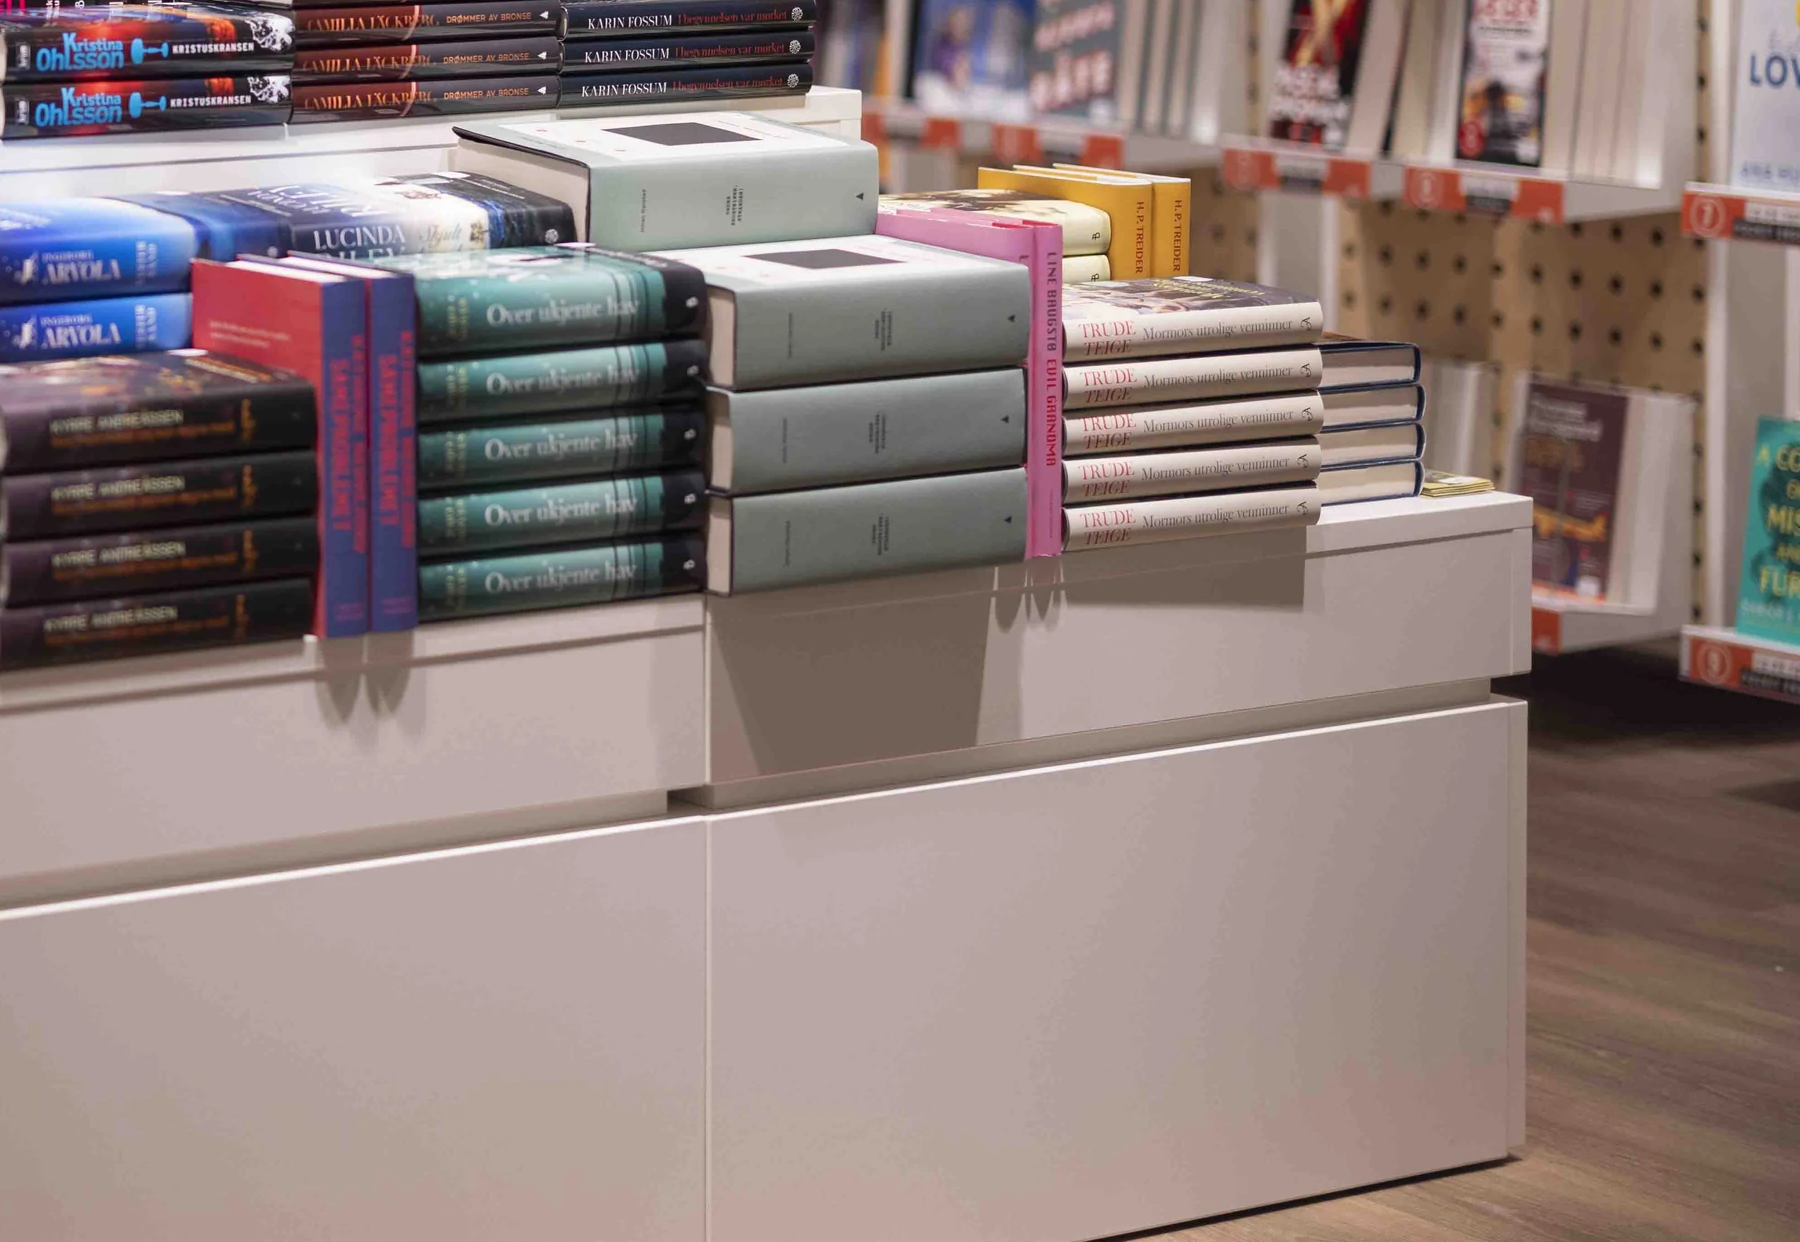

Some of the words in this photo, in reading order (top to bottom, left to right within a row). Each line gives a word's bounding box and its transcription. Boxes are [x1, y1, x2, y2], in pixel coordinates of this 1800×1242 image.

[588, 17, 625, 30] KARIN
[628, 14, 672, 28] FOSSUM
[683, 12, 738, 26] begynnelsen
[741, 13, 754, 22] var
[757, 10, 787, 21] mørket
[61, 32, 124, 51] Kristina
[173, 42, 254, 54] KRISTUSKRANSEN
[36, 45, 124, 71] Ohlsson
[585, 50, 621, 64] KARIN
[625, 48, 669, 61] FOSSUM
[1749, 51, 1800, 89] LOV
[61, 87, 121, 106] Kristina
[170, 95, 251, 108] KRISTUSKRANSEN
[35, 101, 122, 127] Ohlsson
[313, 225, 406, 250] LUCINDA
[1135, 226, 1144, 274] TREIDER
[42, 258, 121, 285] ARVOLA
[1047, 252, 1057, 285] LINE
[486, 303, 532, 327] Over
[539, 301, 602, 325] ukjente
[607, 296, 639, 316] hav
[41, 322, 121, 350] ARVOLA
[1079, 321, 1136, 339] TRUDE
[1143, 325, 1193, 340] Mormors
[1196, 322, 1236, 338] utrolige
[1239, 319, 1293, 333] venninner
[1084, 340, 1131, 356] TEIGE
[1080, 368, 1137, 386] TRUDE
[1085, 387, 1132, 403] TEIGE
[1046, 395, 1057, 466] GRANDMA
